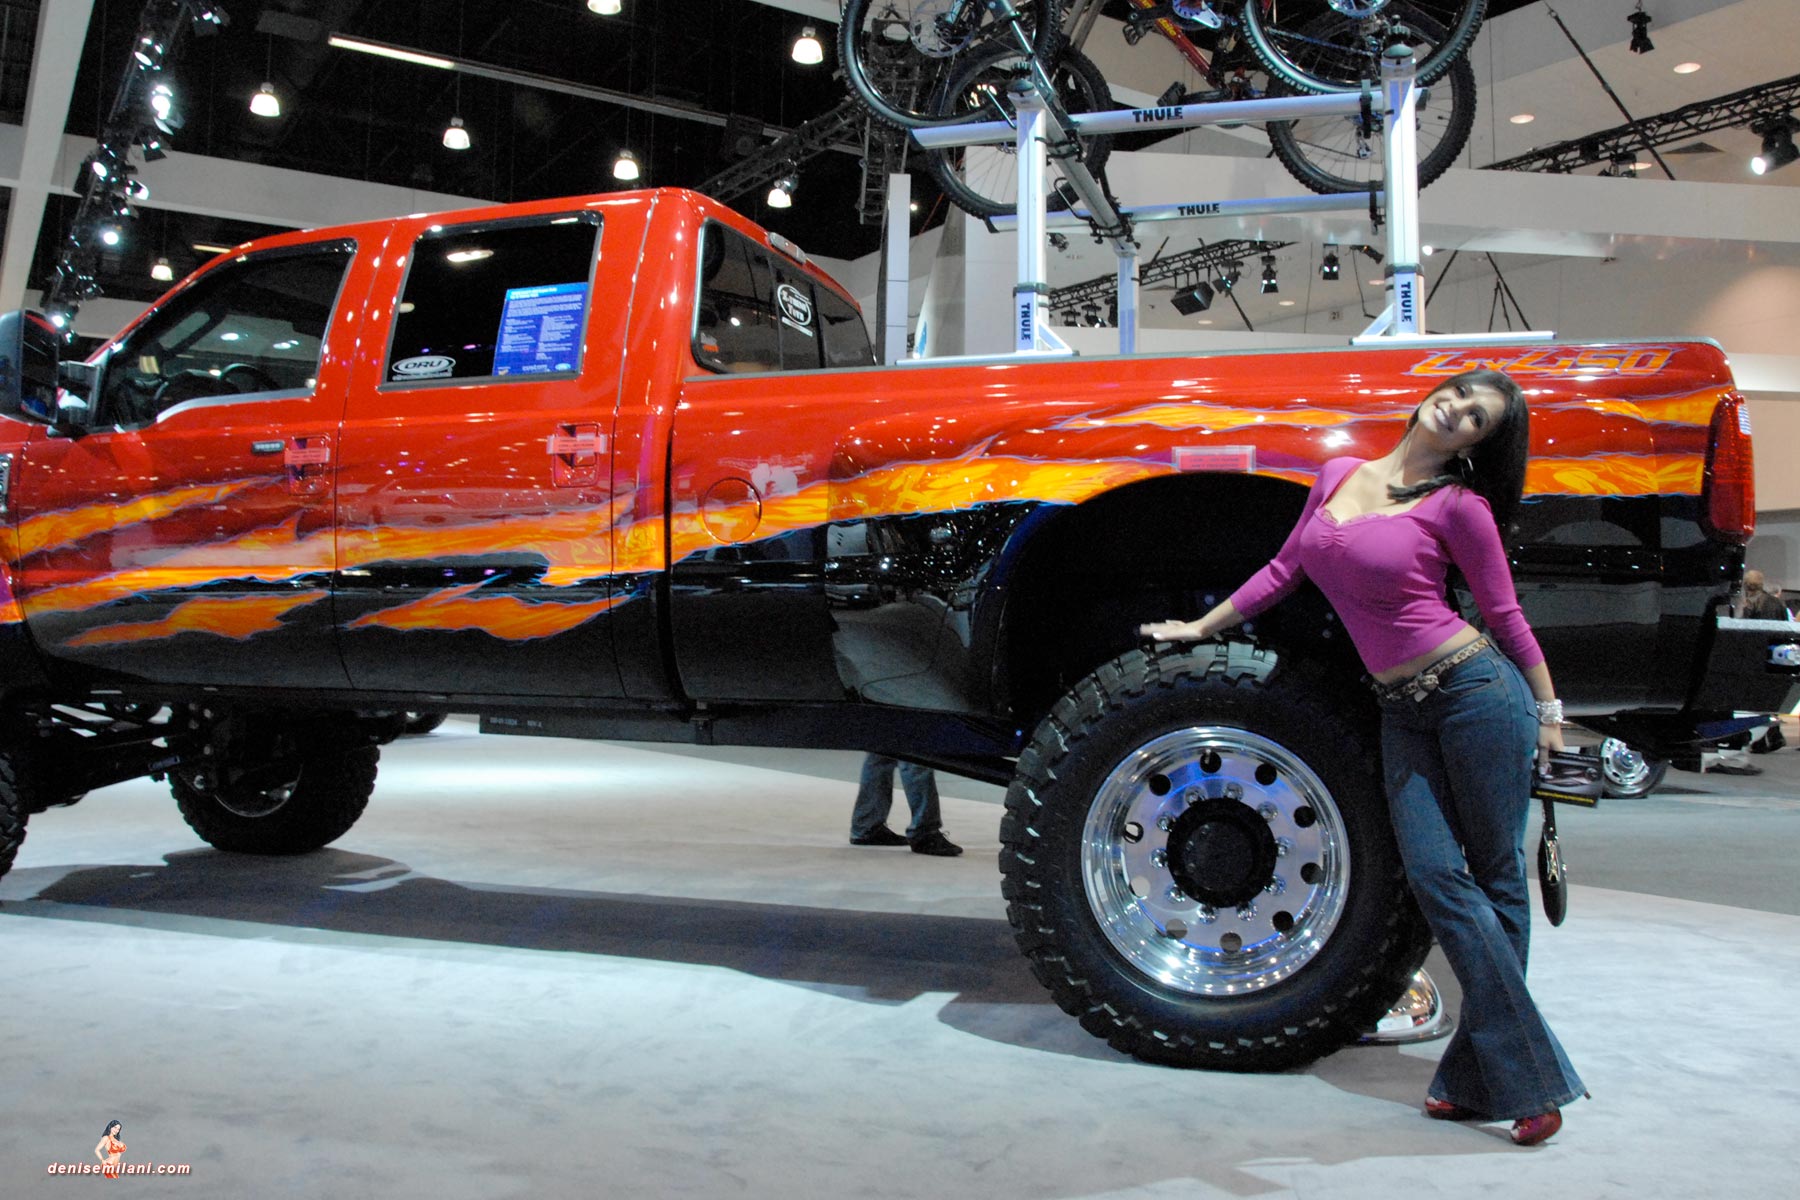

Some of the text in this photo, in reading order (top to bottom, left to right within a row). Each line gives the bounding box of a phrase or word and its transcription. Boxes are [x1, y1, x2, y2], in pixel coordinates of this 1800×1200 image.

[1132, 107, 1184, 123] THULE
[1177, 203, 1220, 217] THULE
[1401, 282, 1412, 323] THULE
[1021, 302, 1031, 341] THULE
